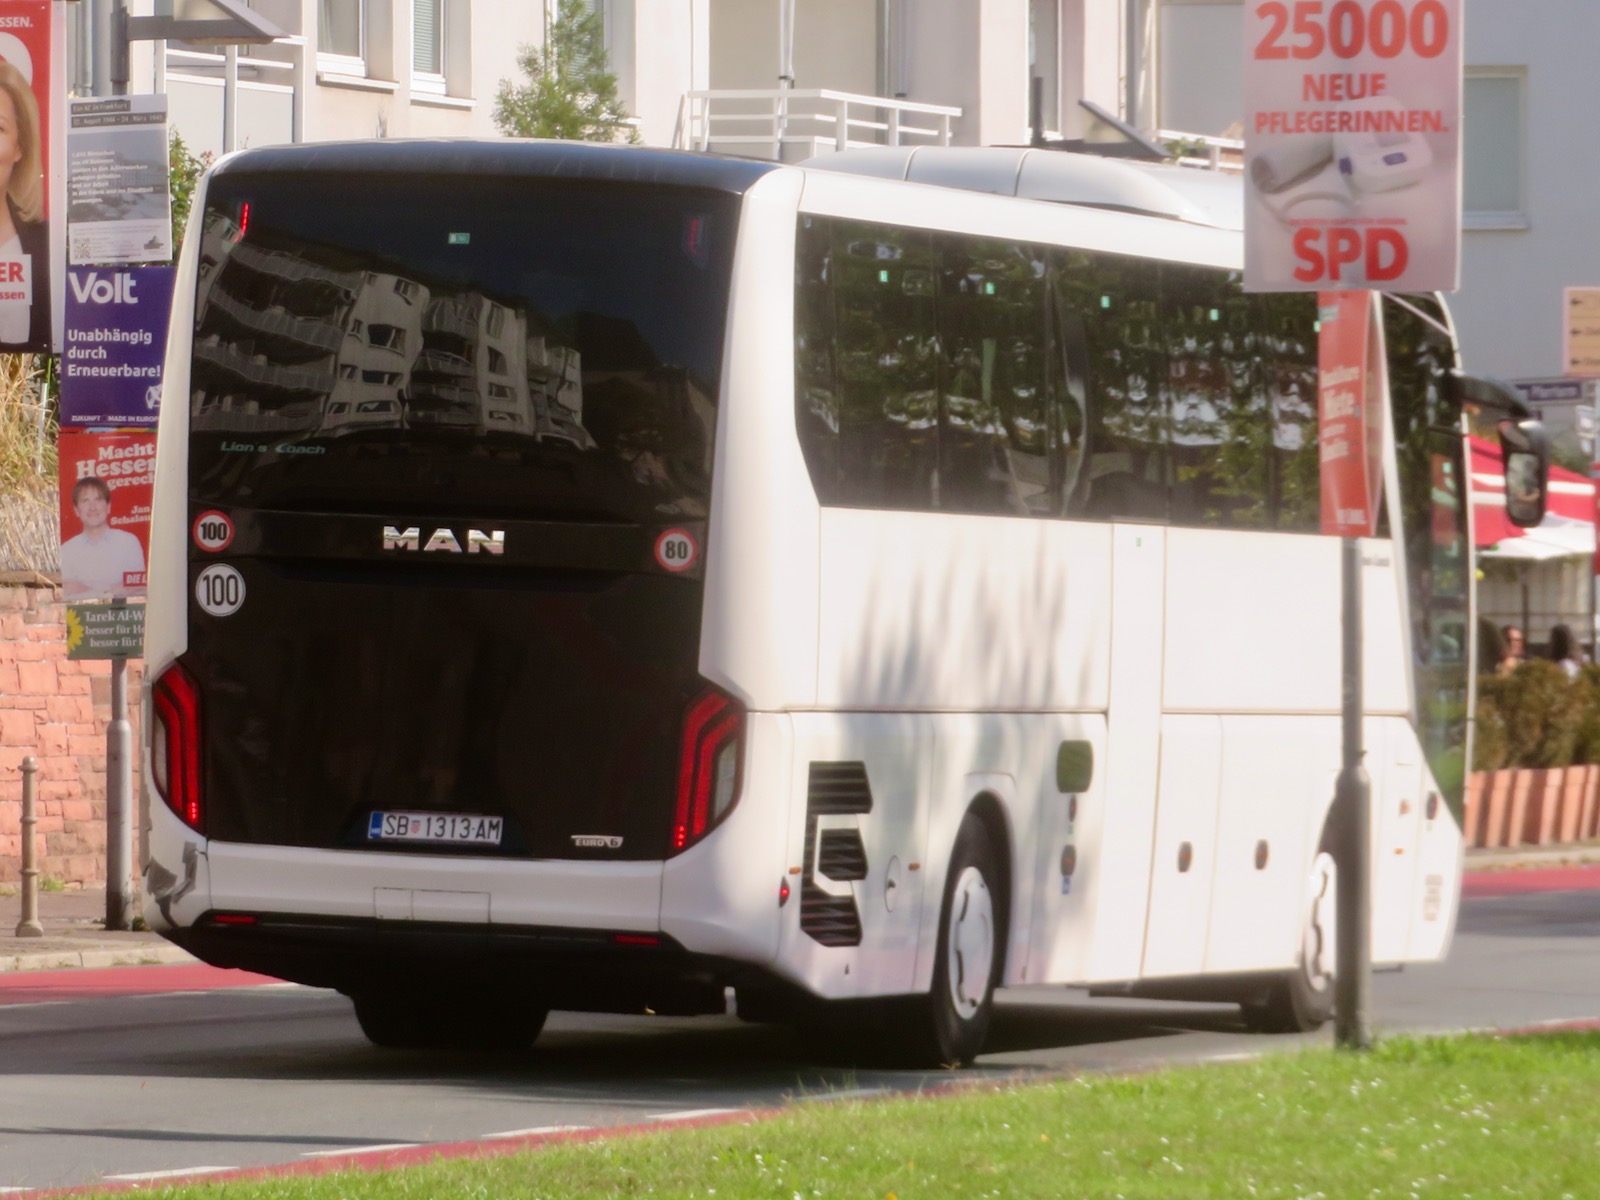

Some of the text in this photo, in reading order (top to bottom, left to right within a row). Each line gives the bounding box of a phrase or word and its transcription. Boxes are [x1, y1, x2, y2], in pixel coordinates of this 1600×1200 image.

[1254, 0, 1449, 60] 25000
[1302, 73, 1387, 102] NEUE
[1254, 110, 1449, 134] PFLEGERINNEN.
[1292, 227, 1409, 283] SPD
[68, 271, 139, 304] Volt
[68, 328, 153, 345] Unabhängig
[68, 346, 107, 359] durch
[68, 363, 161, 378] Erneuerbare!
[98, 443, 155, 461] Macht
[275, 442, 326, 454] Coach
[131, 505, 151, 514] Jan
[200, 522, 228, 541] 100
[383, 525, 505, 554] MAN
[665, 540, 688, 559] 80
[126, 574, 141, 584] DIE
[203, 574, 239, 606] 100
[84, 609, 116, 622] Tarek
[85, 625, 114, 635] besser
[116, 624, 132, 634] für
[90, 637, 120, 647] besser
[122, 636, 138, 647] für
[384, 815, 409, 836] SB
[575, 838, 605, 847] EURO
